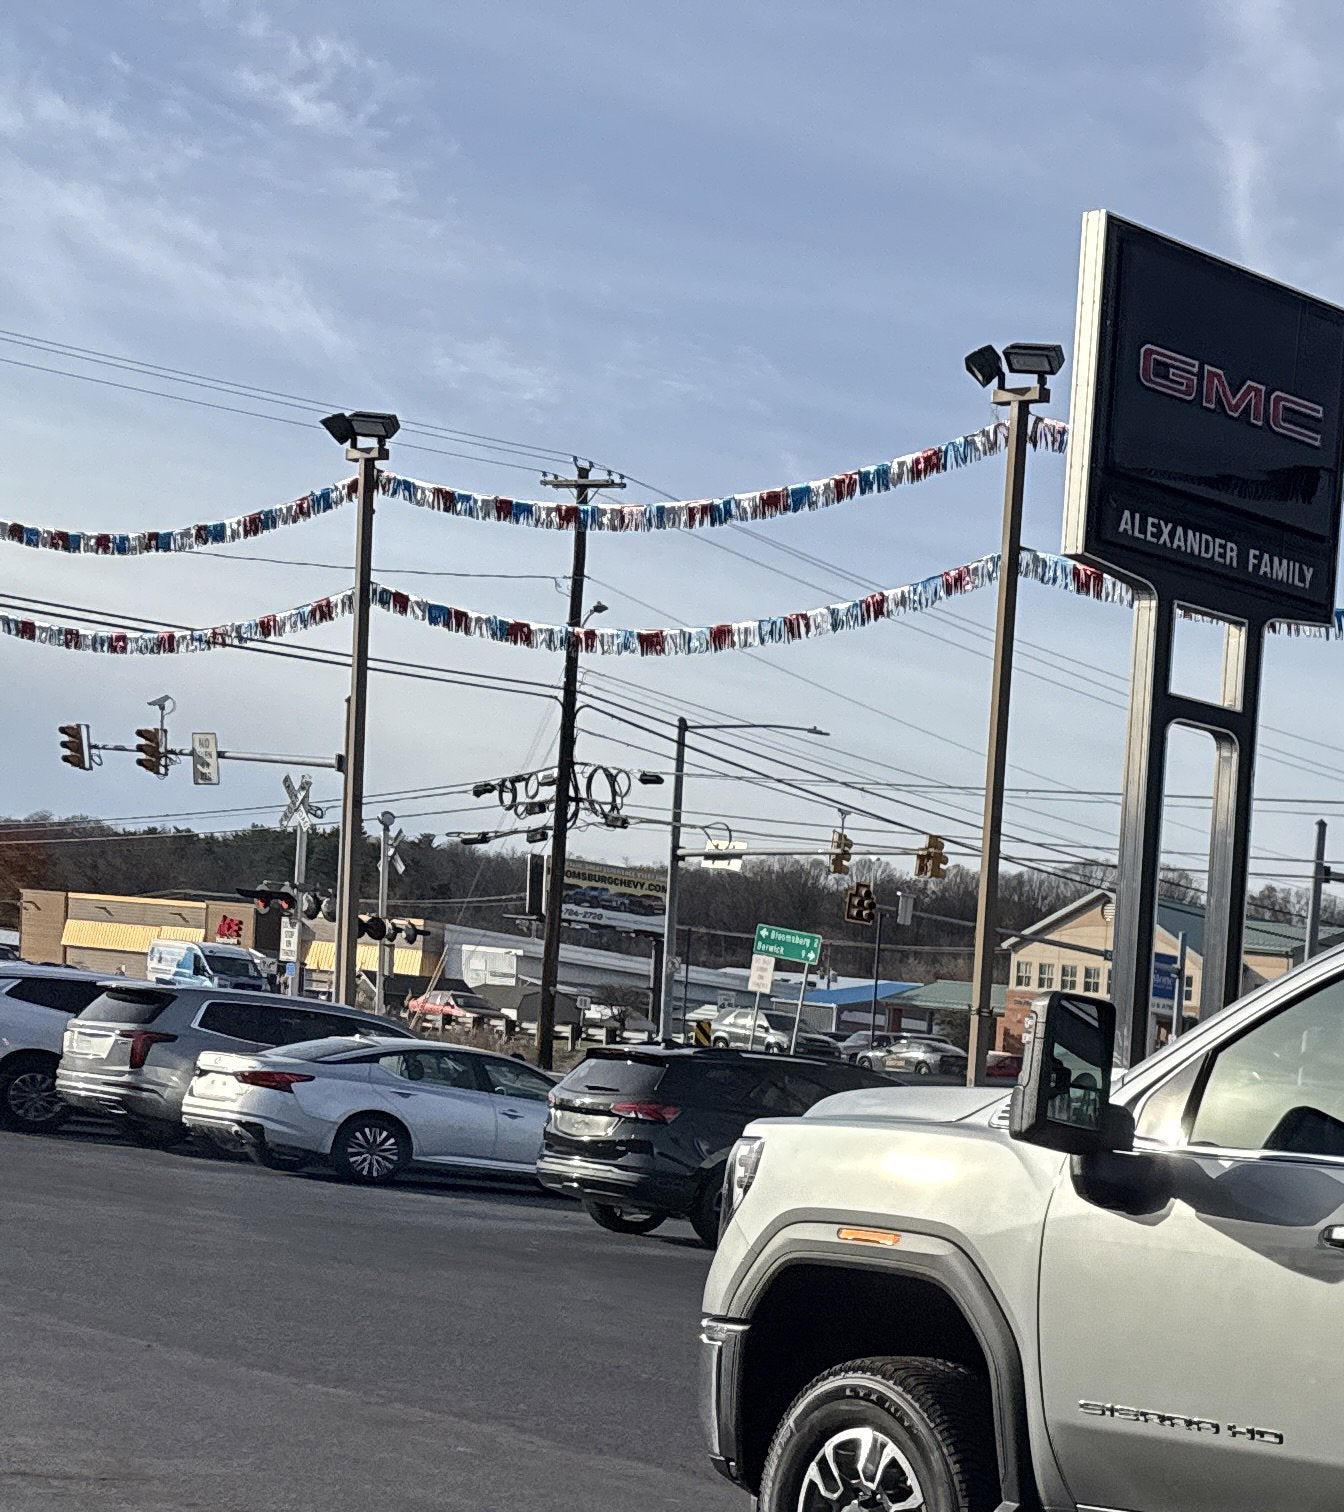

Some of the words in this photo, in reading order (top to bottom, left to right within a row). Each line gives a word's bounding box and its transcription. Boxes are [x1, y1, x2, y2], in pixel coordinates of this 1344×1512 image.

[1140, 344, 1323, 447] GMC
[1118, 509, 1238, 569] ALEXANDER
[1248, 548, 1314, 590] FAMILY
[565, 869, 667, 893] OMSBURGCHEVY.COM
[756, 940, 785, 955] Berwick
[770, 930, 811, 948] Bloomsburg
